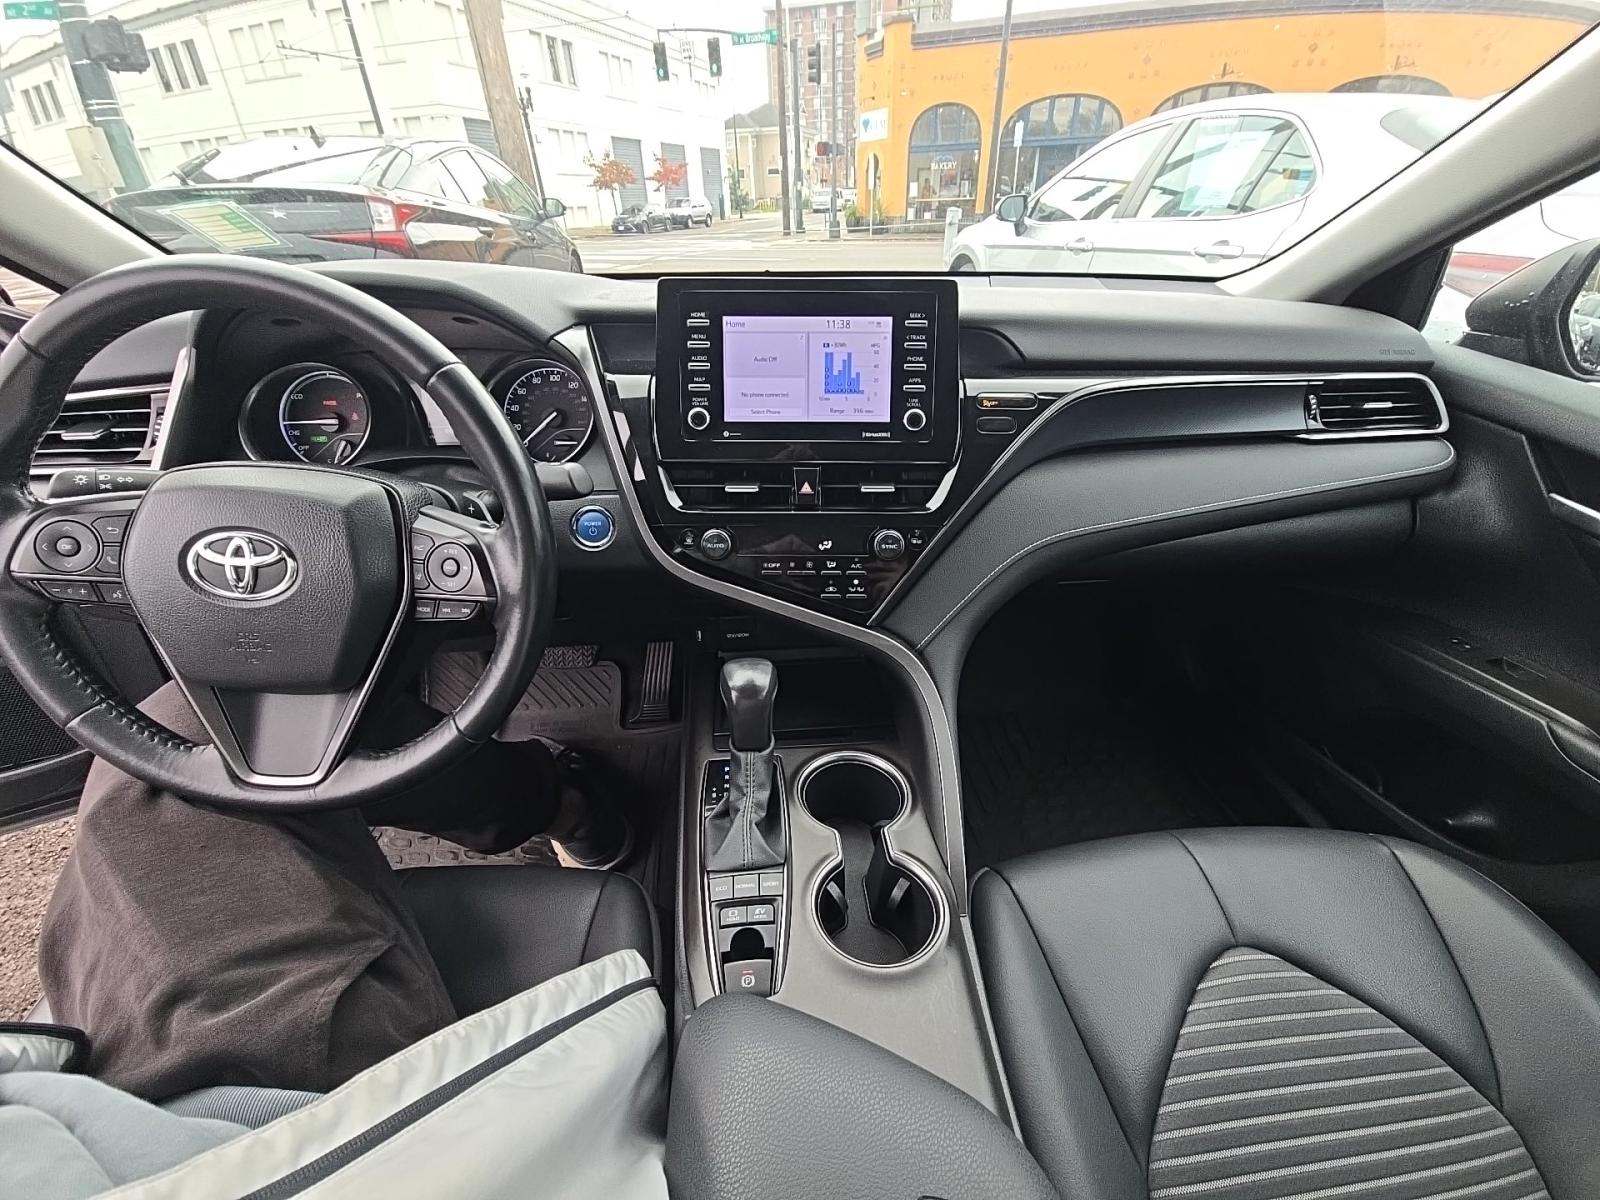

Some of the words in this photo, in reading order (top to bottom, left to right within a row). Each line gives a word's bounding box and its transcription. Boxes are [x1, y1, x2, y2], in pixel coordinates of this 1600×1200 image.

[726, 320, 745, 328] Home
[826, 319, 851, 329] 11:38
[568, 381, 579, 389] 120
